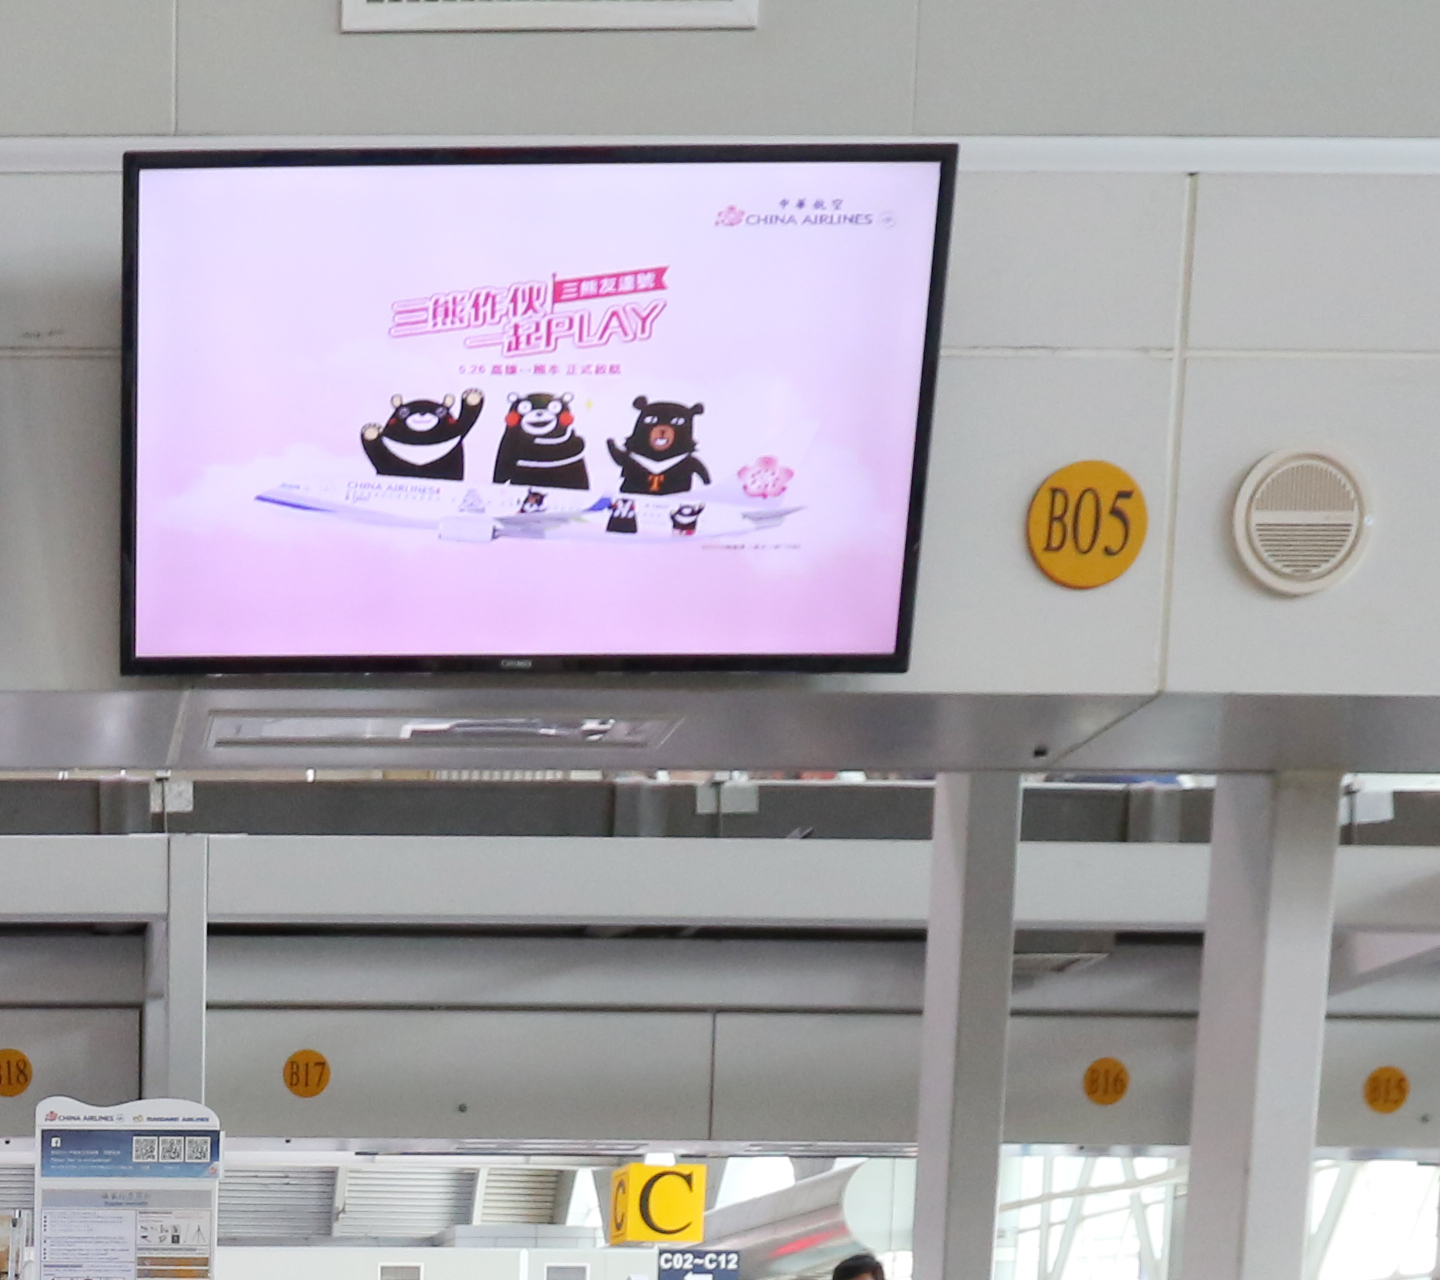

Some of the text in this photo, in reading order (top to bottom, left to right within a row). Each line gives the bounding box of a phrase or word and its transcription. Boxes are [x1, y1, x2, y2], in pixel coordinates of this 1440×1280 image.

[745, 213, 874, 225] CHINA AIRLINES
[1044, 487, 1134, 556] B05
[290, 1061, 326, 1088] B17
[614, 1178, 626, 1232] C
[639, 1171, 694, 1235] C
[660, 1252, 739, 1270] C02~C12
